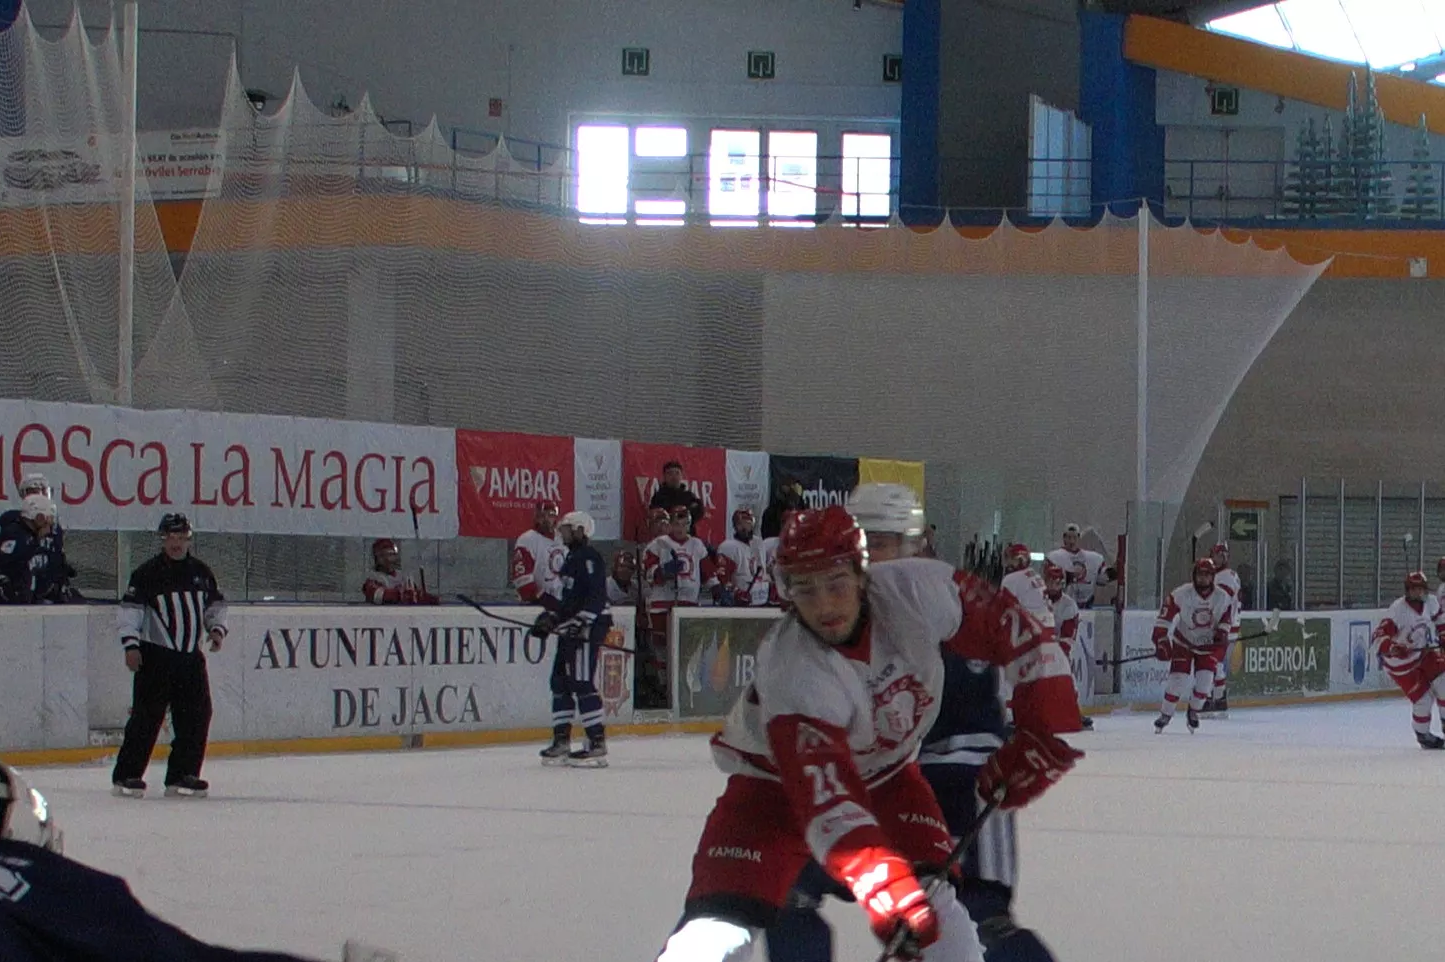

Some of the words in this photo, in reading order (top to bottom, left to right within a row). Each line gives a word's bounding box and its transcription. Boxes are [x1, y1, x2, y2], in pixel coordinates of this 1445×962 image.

[488, 467, 562, 502] AMBAR
[254, 626, 547, 670] AYUNTAMIENTO
[1244, 645, 1318, 674] IBERDROLA
[331, 687, 382, 729] DE
[390, 684, 484, 727] JACA
